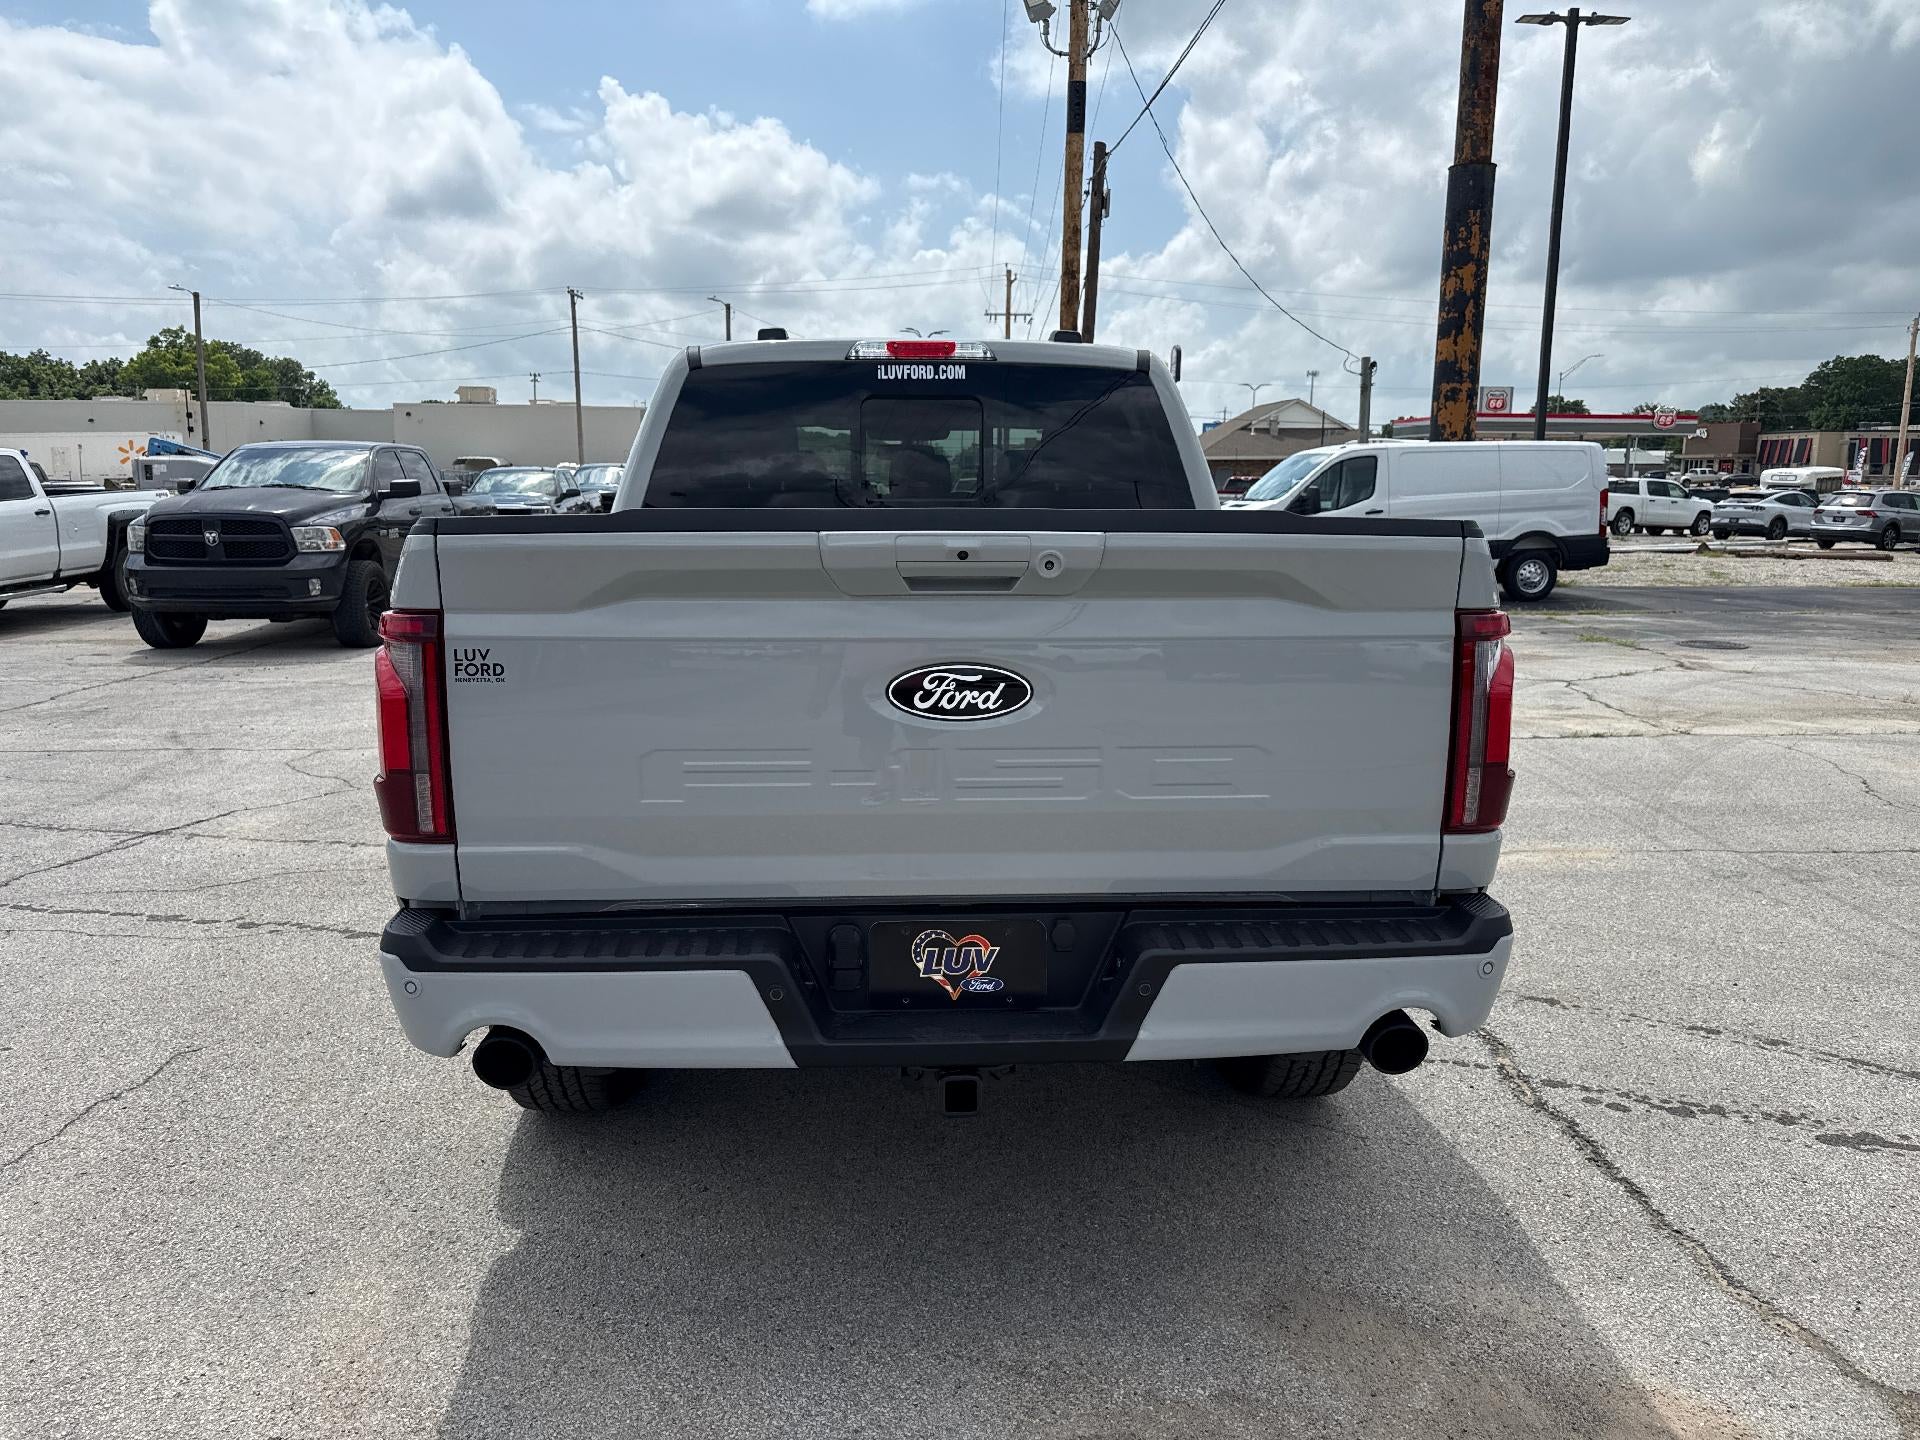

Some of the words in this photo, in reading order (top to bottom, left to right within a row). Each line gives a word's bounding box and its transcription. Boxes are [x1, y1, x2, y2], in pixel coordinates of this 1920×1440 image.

[877, 364, 966, 380] iLUVFORD.COM
[1489, 399, 1504, 409] 66
[1659, 416, 1673, 425] 66
[453, 648, 491, 662] LUV
[454, 662, 505, 677] FORD
[913, 672, 1006, 710] Ford
[919, 946, 1001, 978] LUV
[968, 979, 995, 991] Ford
